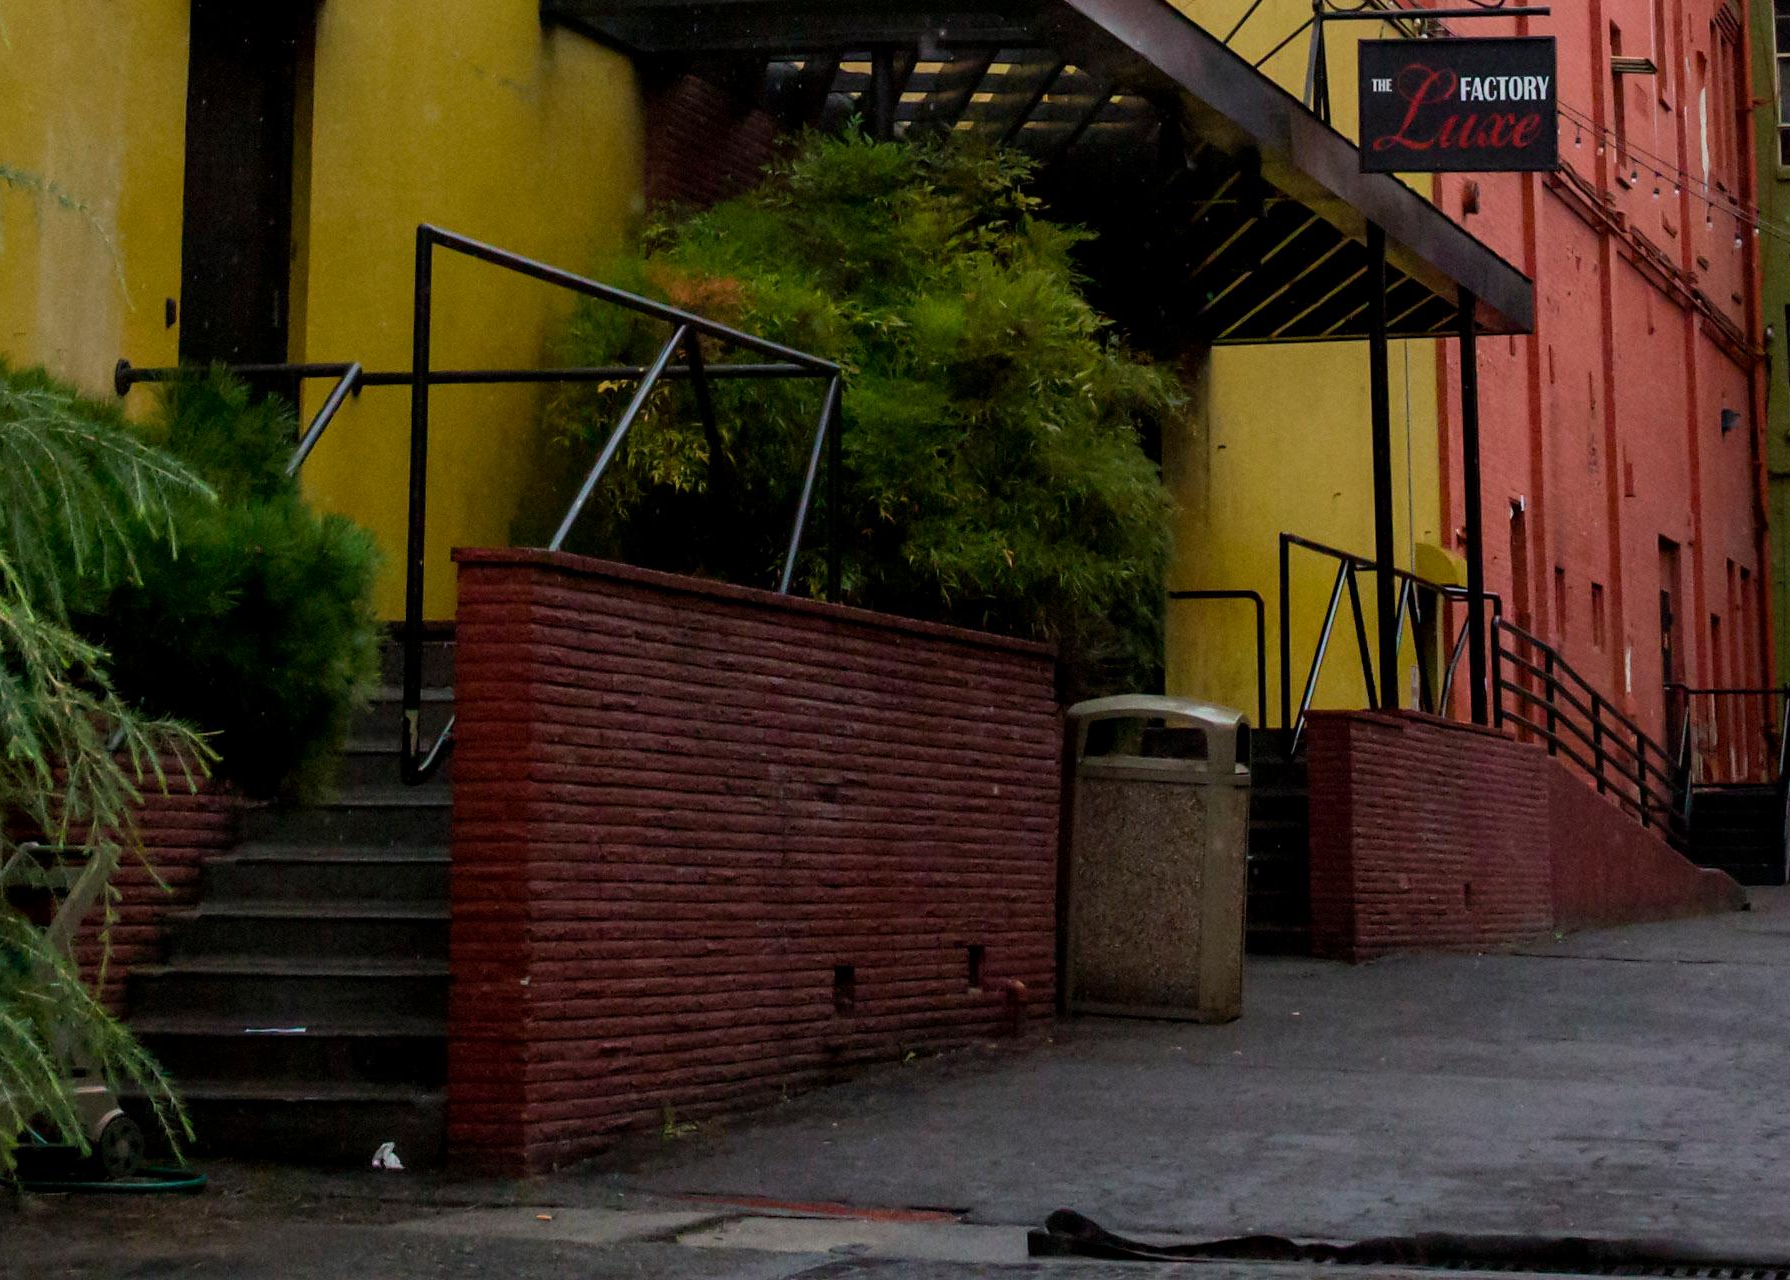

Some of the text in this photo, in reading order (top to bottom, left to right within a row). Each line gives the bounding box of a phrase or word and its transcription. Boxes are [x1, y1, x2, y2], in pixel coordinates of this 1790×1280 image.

[1371, 64, 1550, 151] THE Luxe FACTORY
